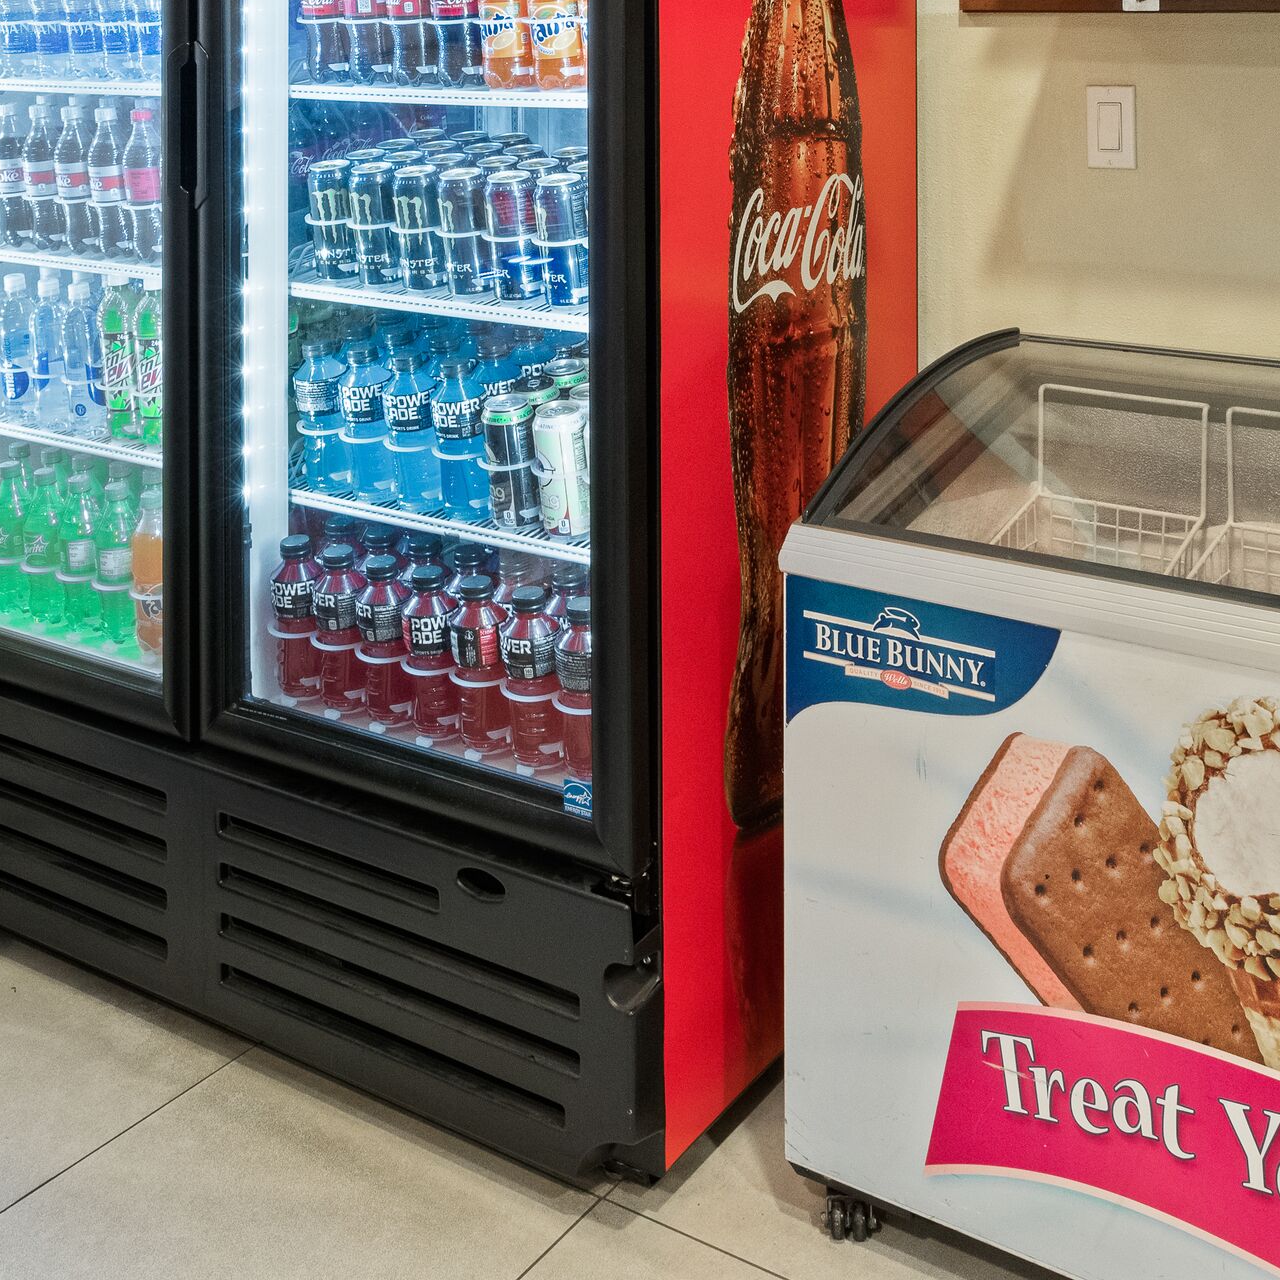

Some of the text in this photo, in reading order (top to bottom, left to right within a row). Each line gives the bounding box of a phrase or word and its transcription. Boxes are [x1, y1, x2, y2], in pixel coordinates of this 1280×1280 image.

[732, 172, 865, 314] Coca-Cola
[815, 622, 985, 687] BLUE BUNNY
[849, 666, 879, 678] QUALITY
[979, 1028, 1197, 1163] Treat
